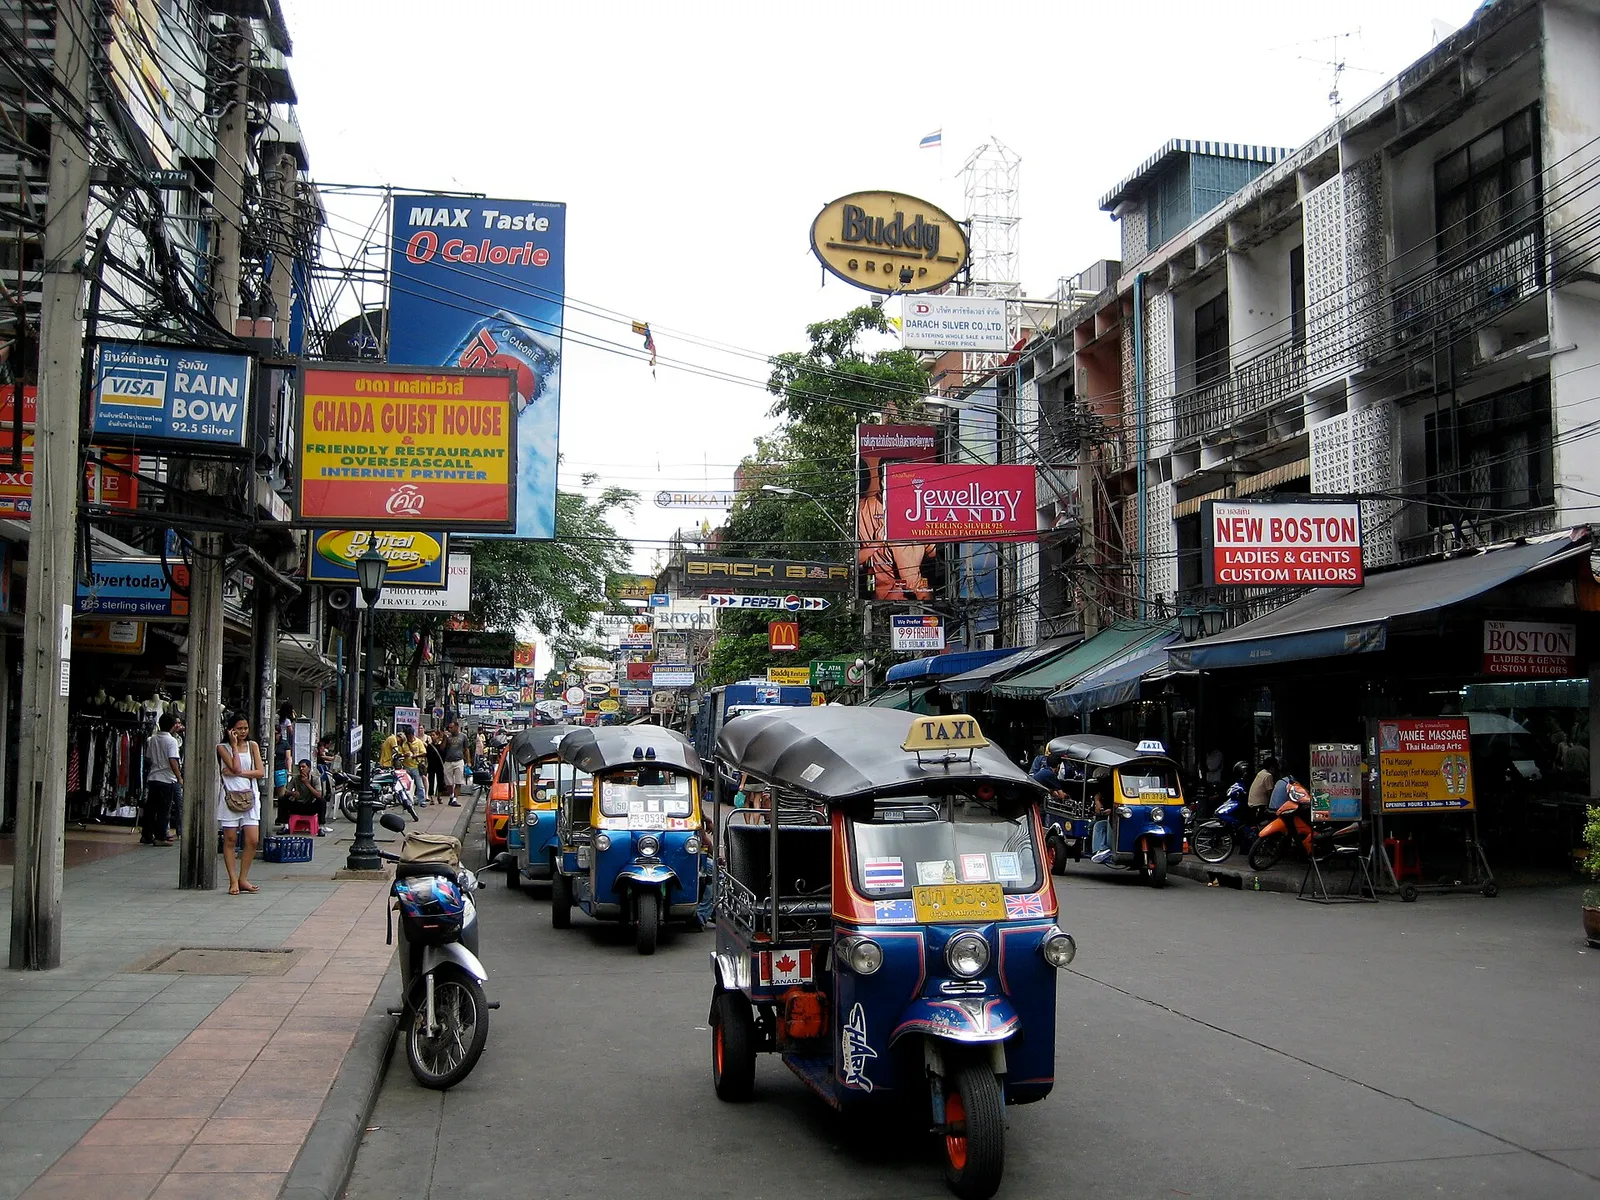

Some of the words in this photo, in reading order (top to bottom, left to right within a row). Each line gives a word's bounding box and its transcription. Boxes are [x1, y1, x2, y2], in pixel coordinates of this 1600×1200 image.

[408, 207, 470, 227] MAX
[482, 210, 549, 231] Taste
[842, 204, 940, 259] Buddy
[441, 238, 550, 266] Calorie
[906, 320, 940, 329] DARACH
[942, 321, 970, 330] SILVER
[509, 336, 540, 362] CALORIE
[111, 378, 155, 396] VISA
[174, 373, 240, 397] RAIN
[172, 398, 238, 423] BOW
[313, 401, 375, 432] CHADA
[381, 403, 438, 435] GUEST
[443, 405, 502, 436] HOUSE
[172, 422, 198, 434] 92.5
[201, 424, 235, 436] Silver
[401, 435, 415, 445] &
[306, 444, 388, 456] FRIENDLY
[395, 446, 505, 458] RESTAURANT
[340, 456, 473, 468] OVERSEASCALL
[321, 467, 405, 478] INTERNET
[673, 495, 718, 505] RIKKA
[925, 508, 1005, 522] LAND
[1217, 518, 1263, 542] NEW
[1270, 517, 1356, 543] BOSTON
[344, 545, 420, 562] Sevices
[1225, 551, 1279, 564] LADIES
[1284, 552, 1296, 563] &
[1300, 551, 1350, 564] GENTS
[448, 566, 469, 576] OUSE
[687, 561, 774, 576] BRICK
[1219, 568, 1289, 581] CUSTOM
[1293, 567, 1357, 580] TAILORS
[102, 600, 138, 612] sterling
[140, 601, 166, 611] silver
[422, 599, 448, 607] ZONE
[741, 597, 781, 608] PEPSI
[659, 612, 711, 623] BAYON
[898, 627, 913, 638] 99
[913, 627, 939, 638] FASHION
[1488, 630, 1572, 653] BOSTON
[1493, 655, 1526, 664] LADIES
[1537, 657, 1566, 665] GENTS
[770, 669, 790, 678] Buddy
[1490, 664, 1527, 673] CUSTOM
[1530, 665, 1568, 674] TAILORS
[922, 720, 976, 741] TAXI
[1398, 730, 1425, 741] YANEE
[1428, 729, 1468, 741] MASSAGE
[1405, 742, 1420, 750] Thai
[1421, 743, 1445, 752] Healing
[1446, 742, 1462, 750] Arts
[1312, 751, 1339, 767] Motor
[1341, 751, 1361, 767] bike
[1325, 768, 1349, 784] Taxi
